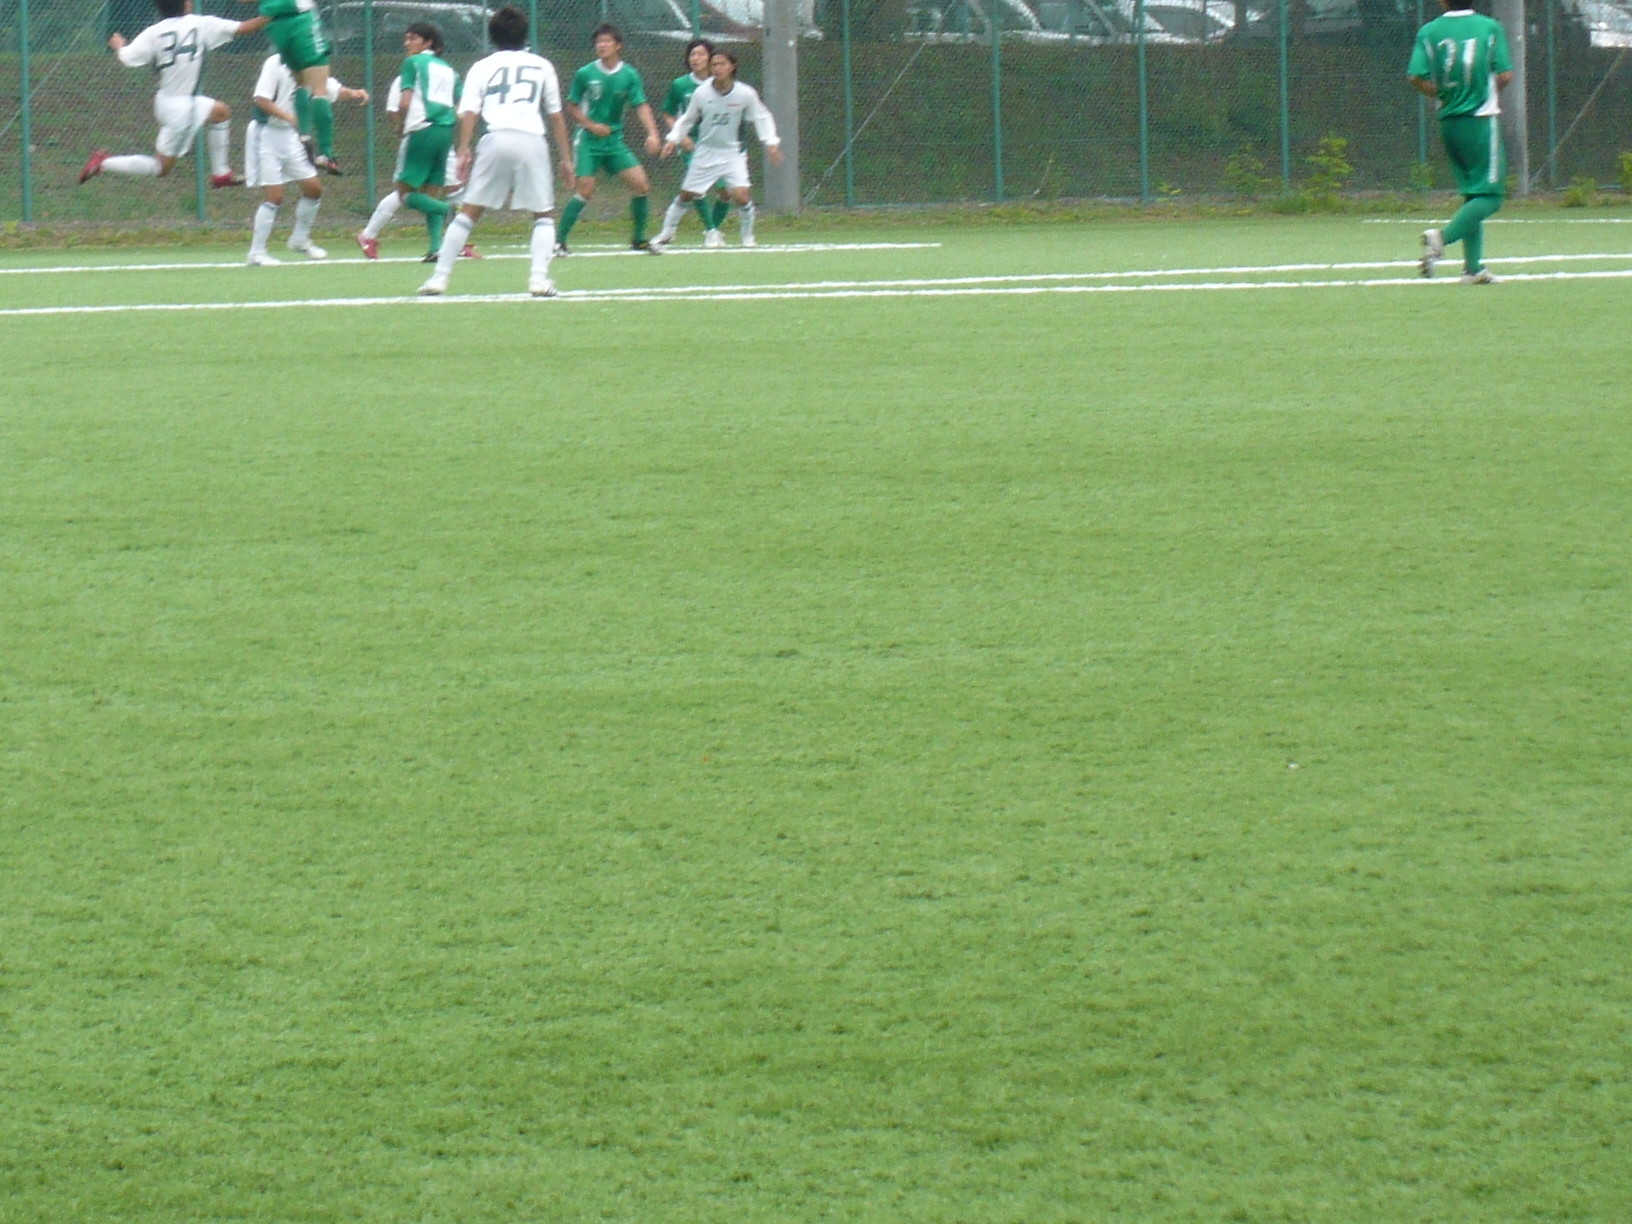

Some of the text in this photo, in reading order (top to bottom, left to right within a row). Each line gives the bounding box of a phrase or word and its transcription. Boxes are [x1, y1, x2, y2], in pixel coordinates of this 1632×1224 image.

[157, 27, 198, 71] 34
[1436, 37, 1477, 87] 21
[484, 65, 542, 104] 45
